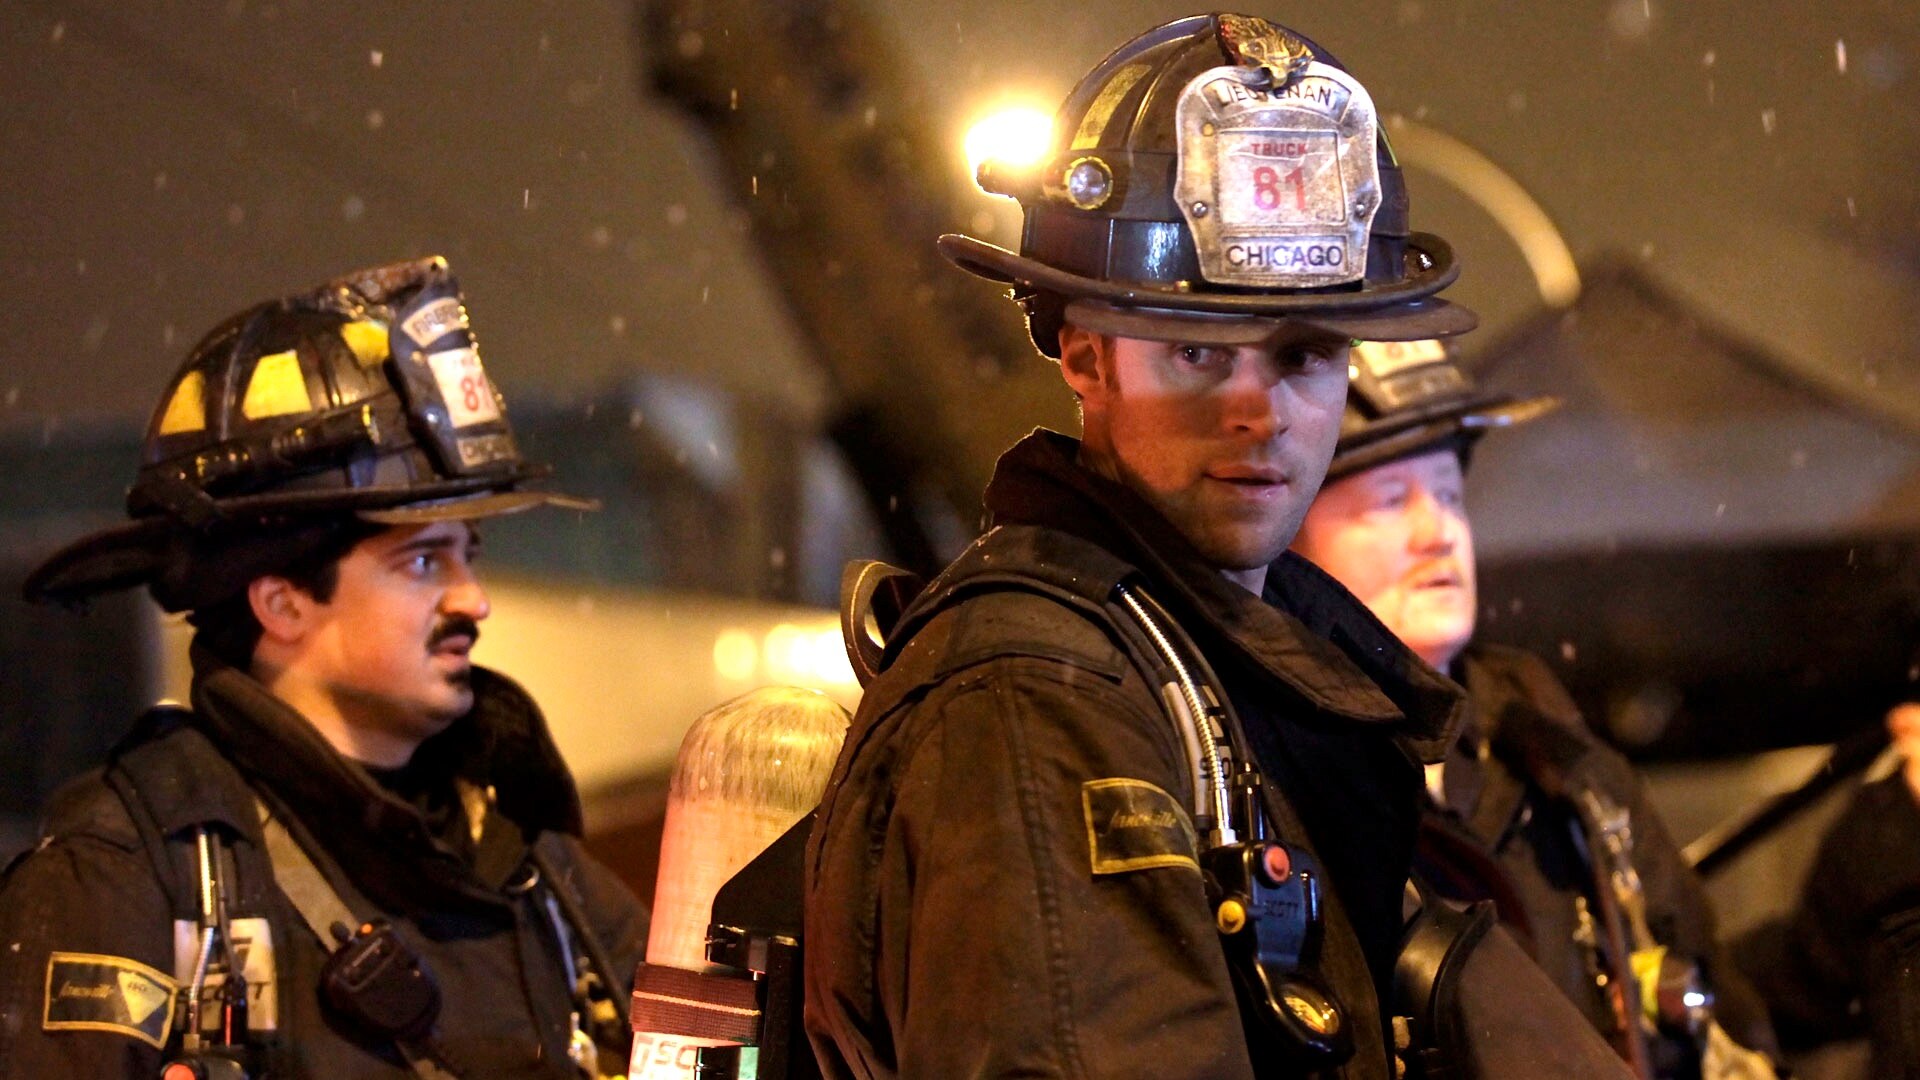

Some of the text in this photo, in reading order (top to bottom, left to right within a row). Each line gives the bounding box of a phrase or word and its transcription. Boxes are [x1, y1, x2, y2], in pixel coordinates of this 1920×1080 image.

[1251, 142, 1307, 156] TRUCK
[1252, 165, 1307, 211] 81
[1226, 244, 1343, 268] CHICAGO
